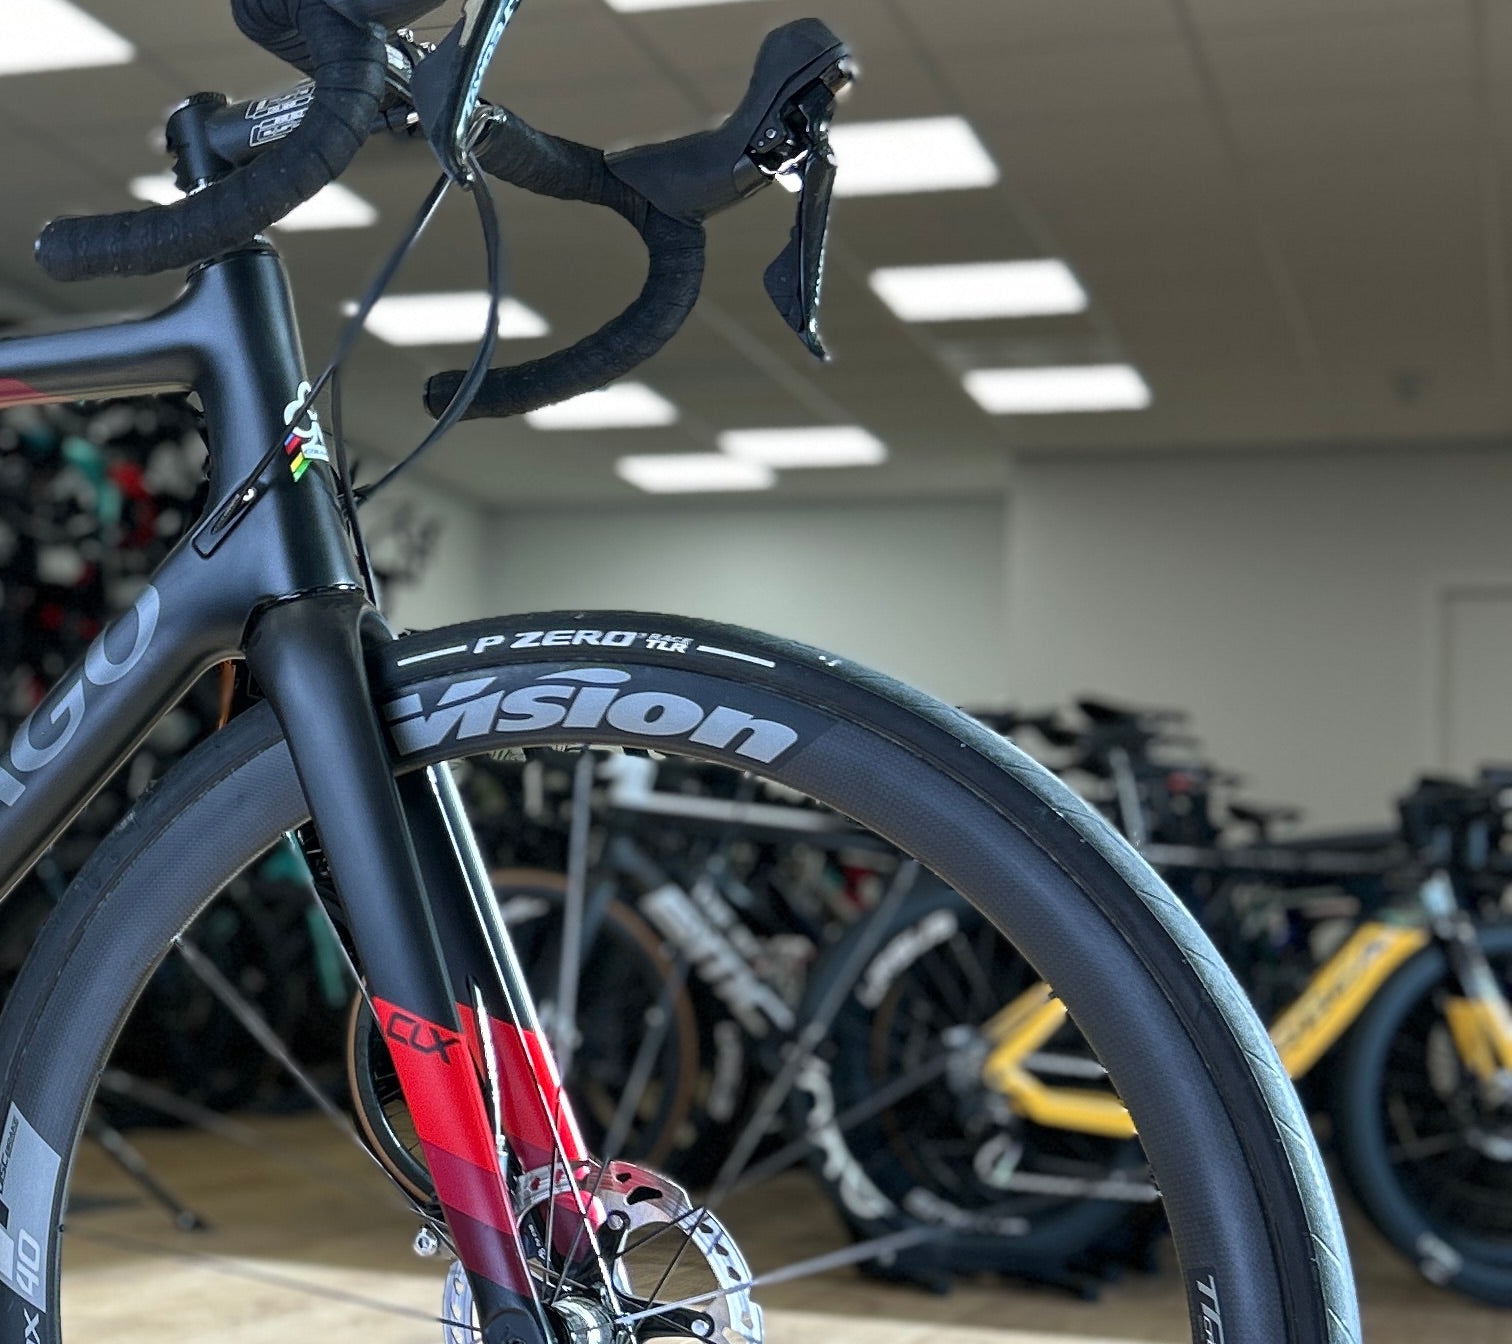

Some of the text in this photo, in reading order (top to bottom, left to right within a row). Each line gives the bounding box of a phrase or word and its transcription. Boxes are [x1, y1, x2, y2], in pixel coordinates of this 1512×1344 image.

[473, 635, 505, 654] P
[510, 629, 637, 649] ZERO
[645, 639, 688, 654] TLR
[387, 668, 798, 764] Vision
[388, 1011, 461, 1066] CLX
[16, 1228, 41, 1298] 40
